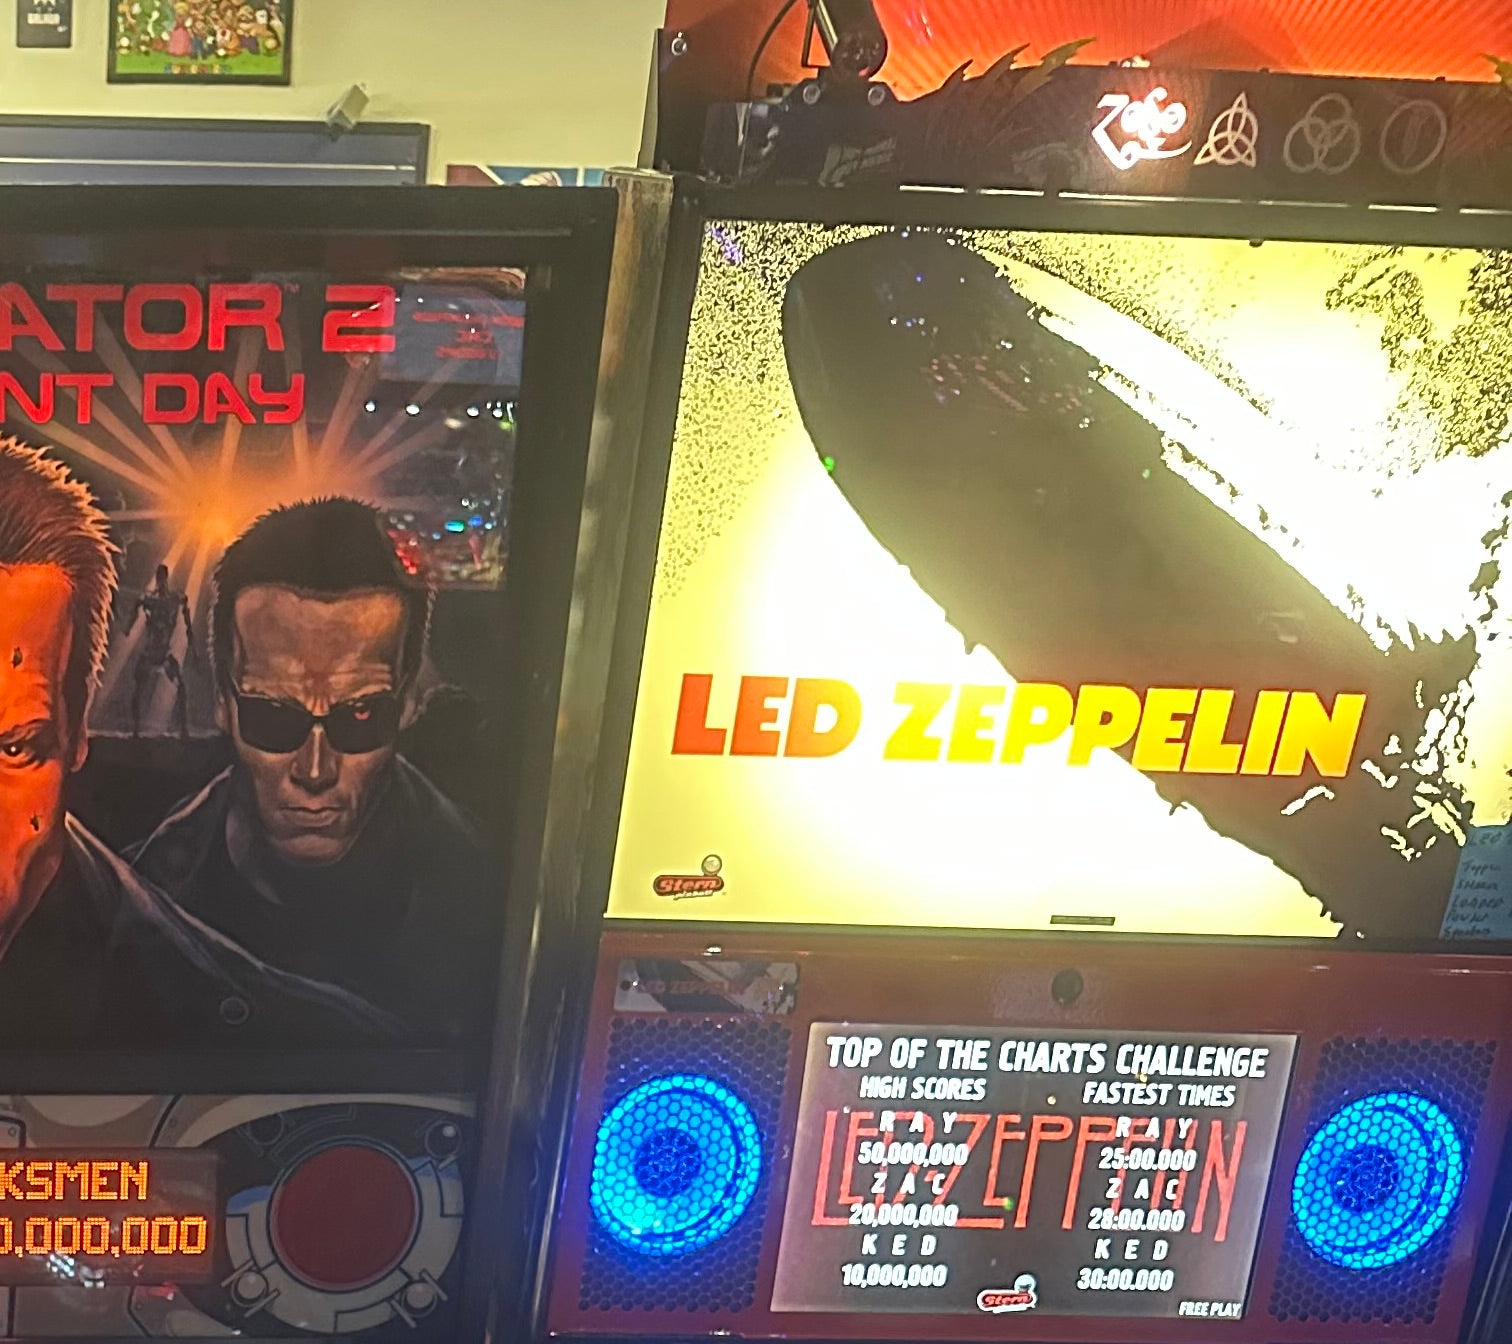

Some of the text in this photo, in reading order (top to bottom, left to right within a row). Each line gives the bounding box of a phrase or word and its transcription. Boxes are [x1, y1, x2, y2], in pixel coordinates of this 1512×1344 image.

[322, 284, 396, 352] 2
[142, 373, 305, 424] DAY
[671, 673, 1367, 778] LED ZEPPELIN
[658, 876, 719, 893] Stern
[827, 1036, 1270, 1079] TOP OF THE CHARTS CHALLENGE
[859, 1076, 987, 1101] HIGH SCORES
[1083, 1081, 1236, 1108] FASTEST TIMES
[857, 1142, 969, 1168] 50,000,000
[848, 1204, 958, 1229] 20,000,000
[840, 1262, 948, 1288] 10,000,000
[1178, 1301, 1242, 1318] FREE PLAY
